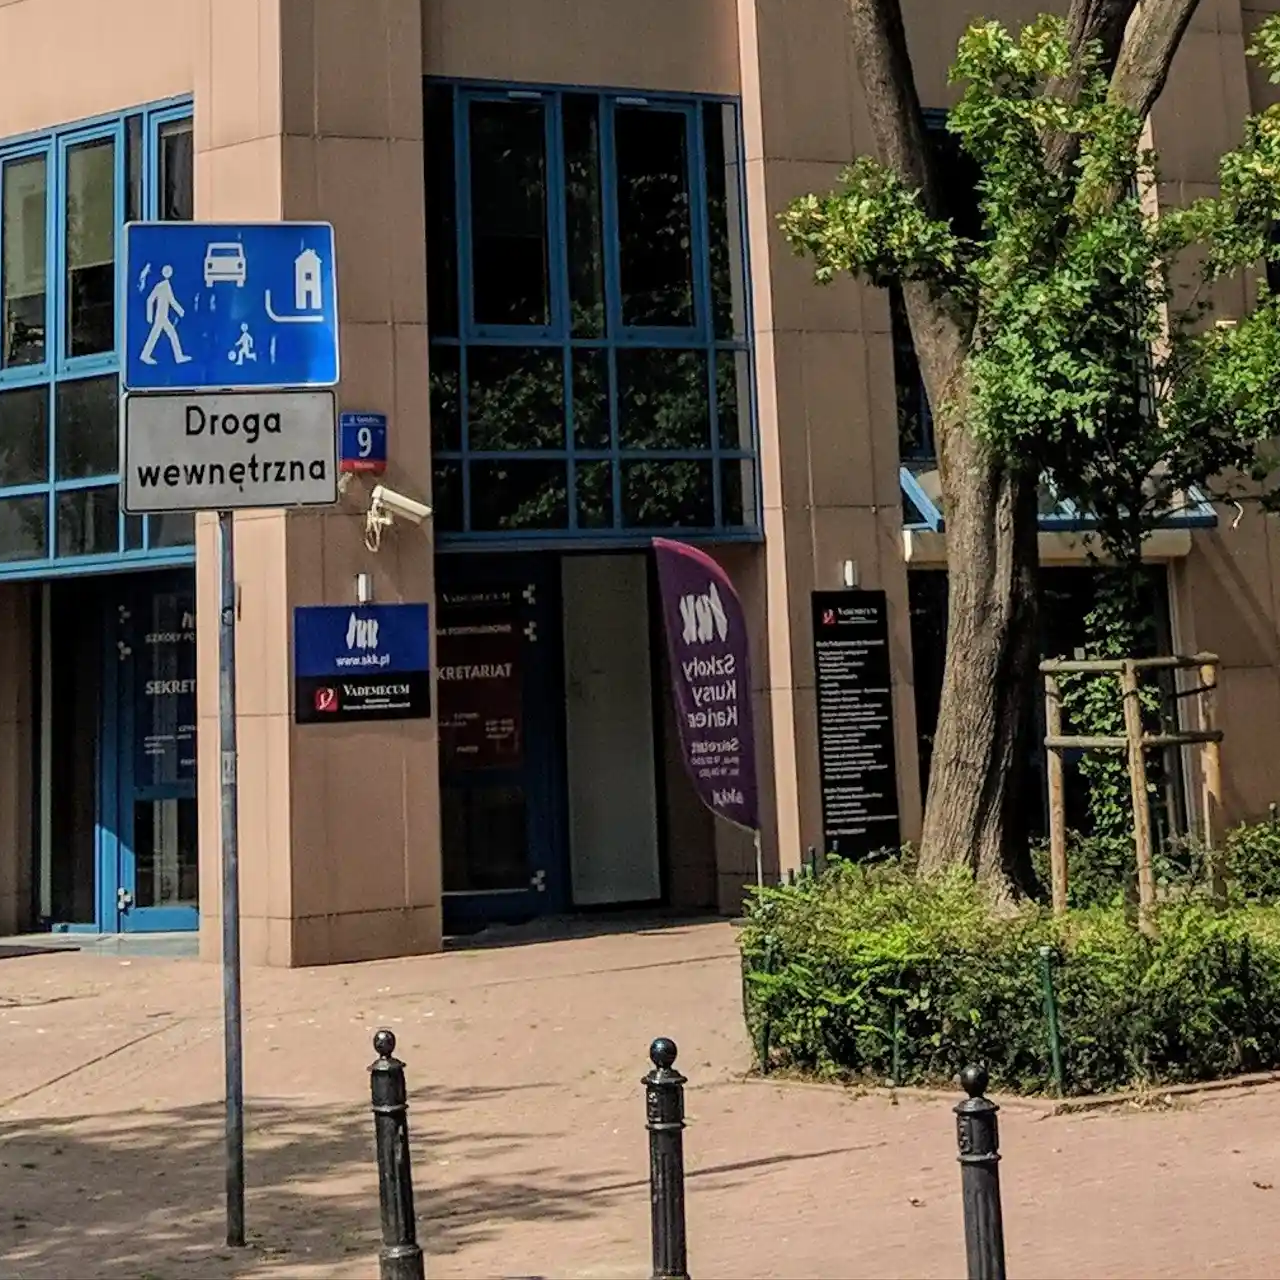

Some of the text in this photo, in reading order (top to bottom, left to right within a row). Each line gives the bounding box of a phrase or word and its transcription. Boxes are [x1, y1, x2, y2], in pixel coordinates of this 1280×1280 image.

[185, 405, 281, 443] Droga
[357, 427, 372, 458] 9
[137, 453, 326, 493] wewnętrzna
[436, 662, 513, 681] KRETARIAT
[145, 679, 197, 696] SEKRET
[342, 684, 410, 697] VADEMECUM
